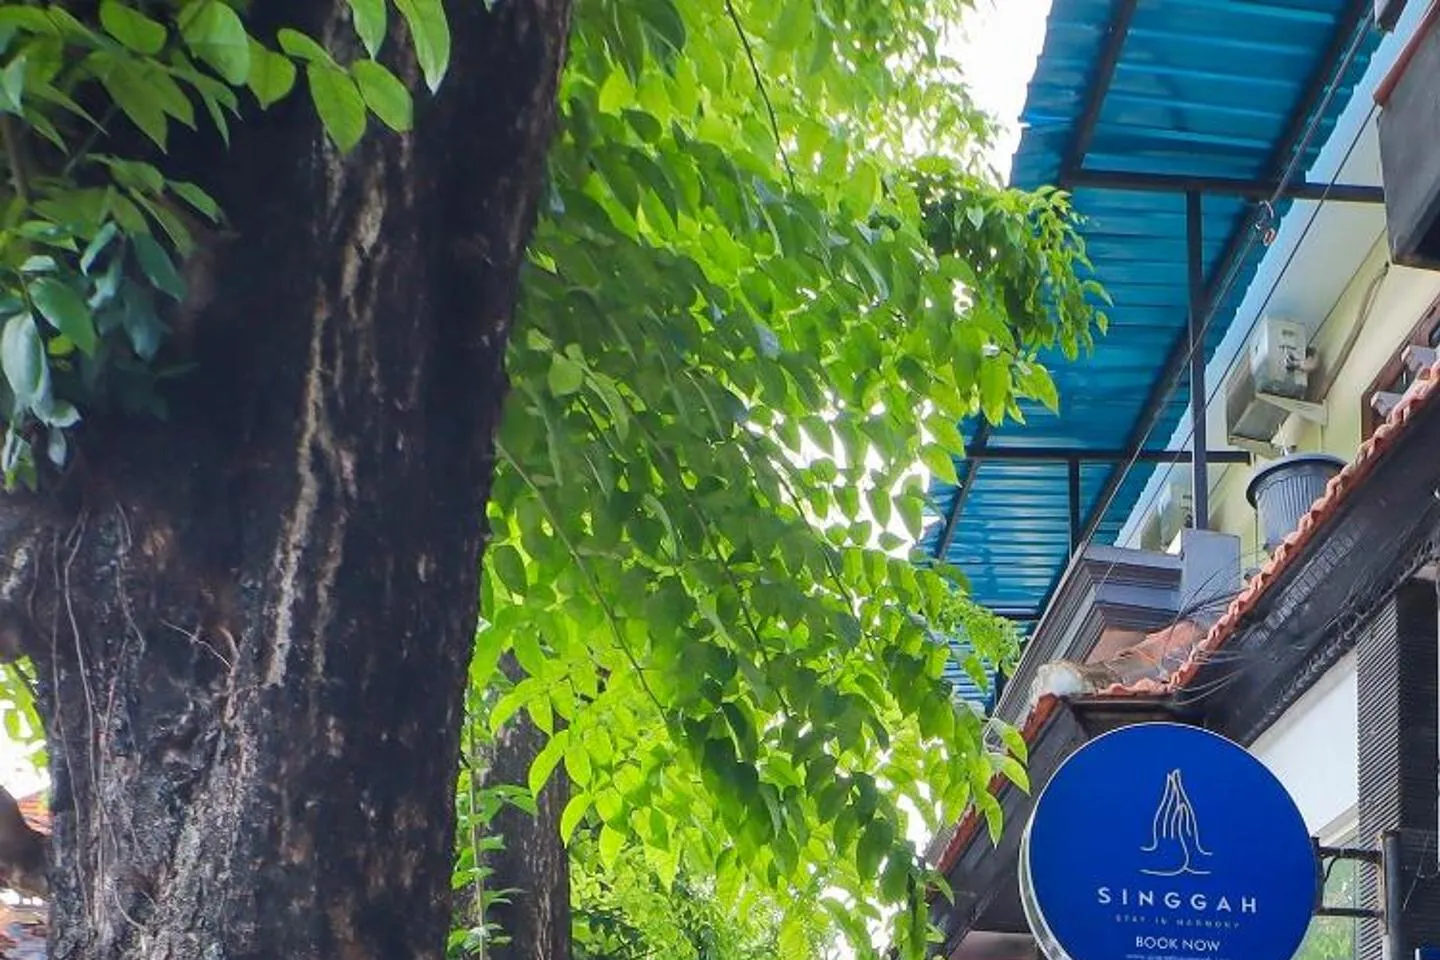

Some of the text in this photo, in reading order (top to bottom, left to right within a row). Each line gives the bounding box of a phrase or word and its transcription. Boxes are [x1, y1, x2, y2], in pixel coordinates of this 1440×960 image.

[1097, 886, 1257, 914] SINGGAH
[1115, 913, 1241, 929] STAY IN HARMONY
[1135, 935, 1220, 952] BOOK NOW
